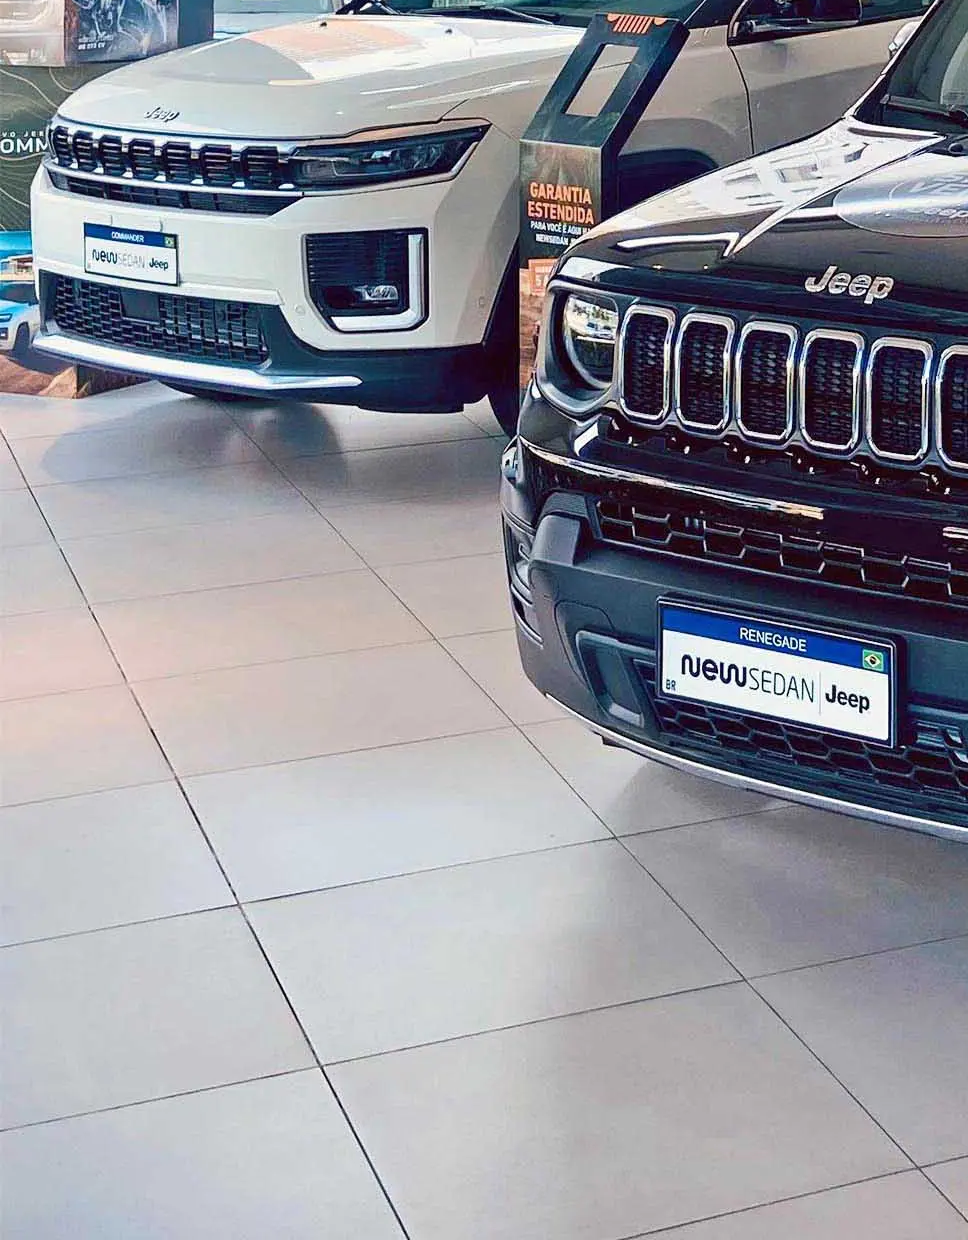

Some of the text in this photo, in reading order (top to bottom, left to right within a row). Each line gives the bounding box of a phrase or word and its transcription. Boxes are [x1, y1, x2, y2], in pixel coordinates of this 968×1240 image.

[143, 106, 181, 123] Jeep
[529, 181, 593, 205] GARANTIA
[527, 200, 595, 225] ESTENDIDA
[530, 220, 547, 231] PARA
[111, 231, 145, 243] COMMANDER
[149, 258, 169, 271] Jeep
[804, 265, 895, 304] Jeep
[739, 627, 808, 653] RENEGADE
[665, 678, 676, 691] BR
[825, 684, 870, 713] Jeep
